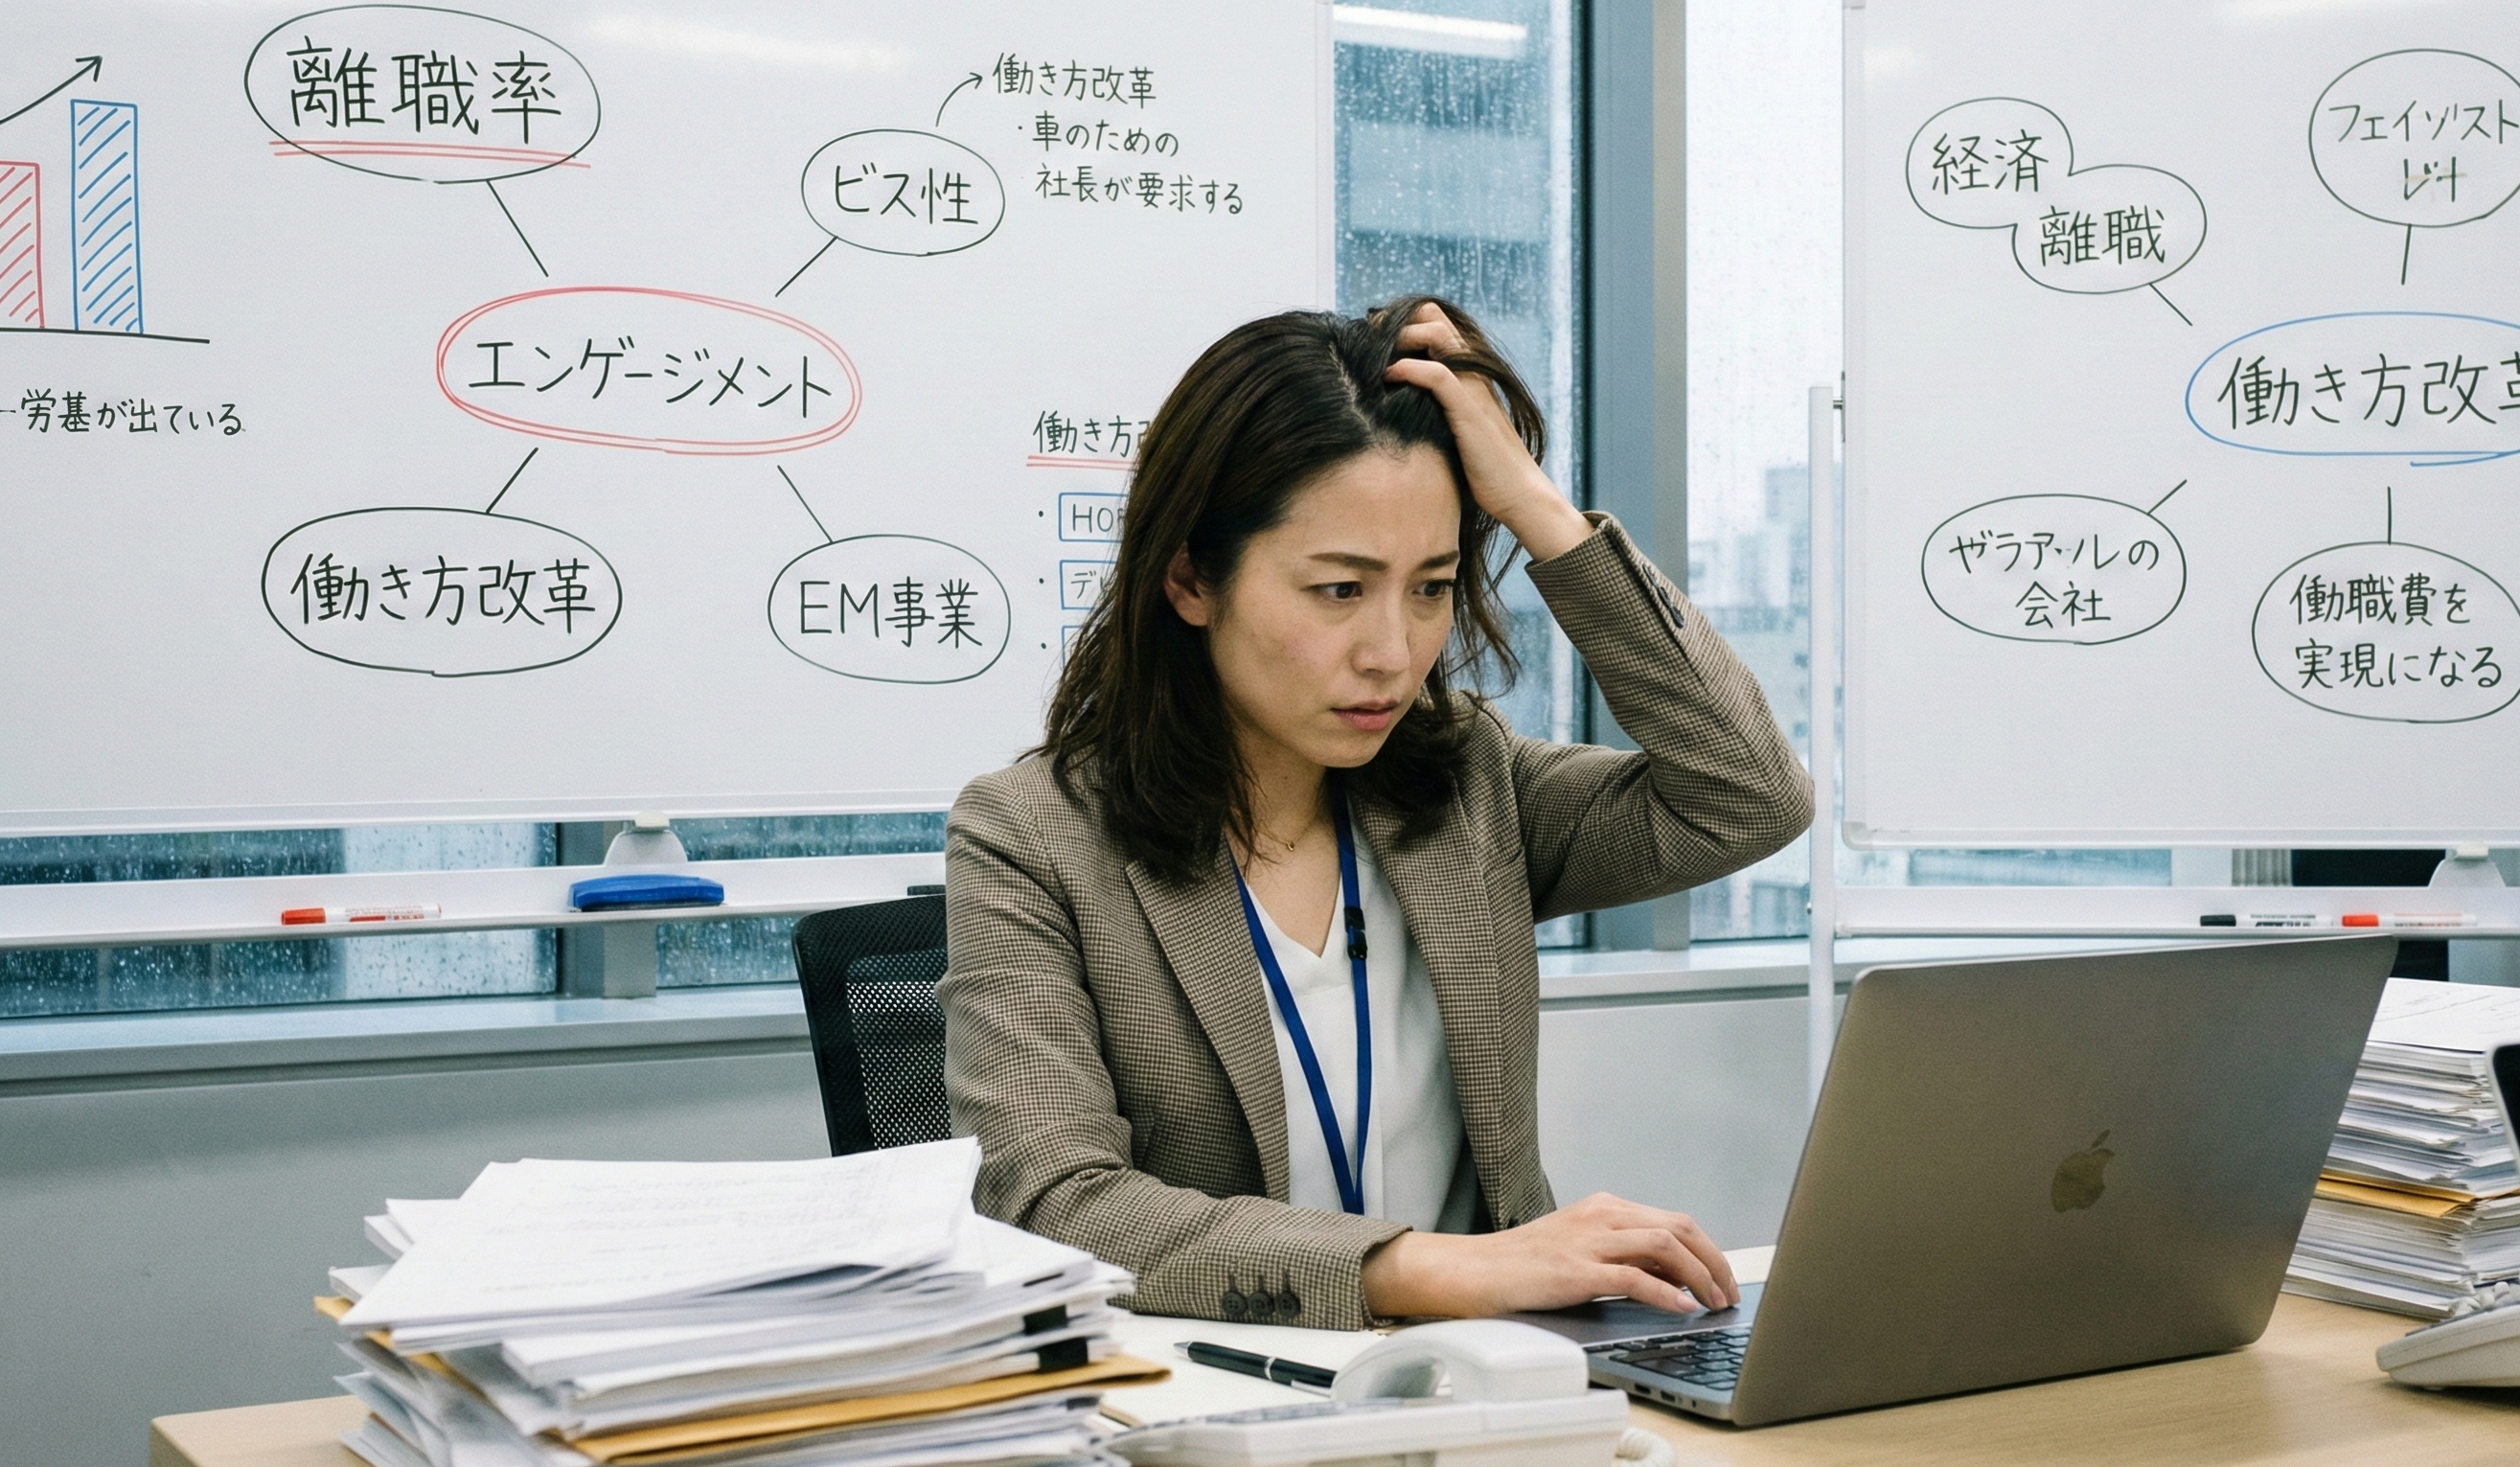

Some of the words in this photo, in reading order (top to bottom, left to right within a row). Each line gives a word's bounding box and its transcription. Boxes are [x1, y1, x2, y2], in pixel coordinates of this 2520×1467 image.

[286, 35, 561, 144] 離職率
[992, 52, 1157, 109] 働き方改革
[1035, 163, 1244, 215] 社長が要求する
[1932, 128, 2049, 195] 経済
[834, 163, 978, 225] ビス性
[2039, 205, 2165, 266] 離職
[469, 335, 832, 419] エンゲージメント
[290, 552, 597, 634] 働き方改革
[797, 577, 982, 650] EM事業
[2015, 581, 2112, 629] 会社
[2295, 637, 2502, 689] 実現になる
